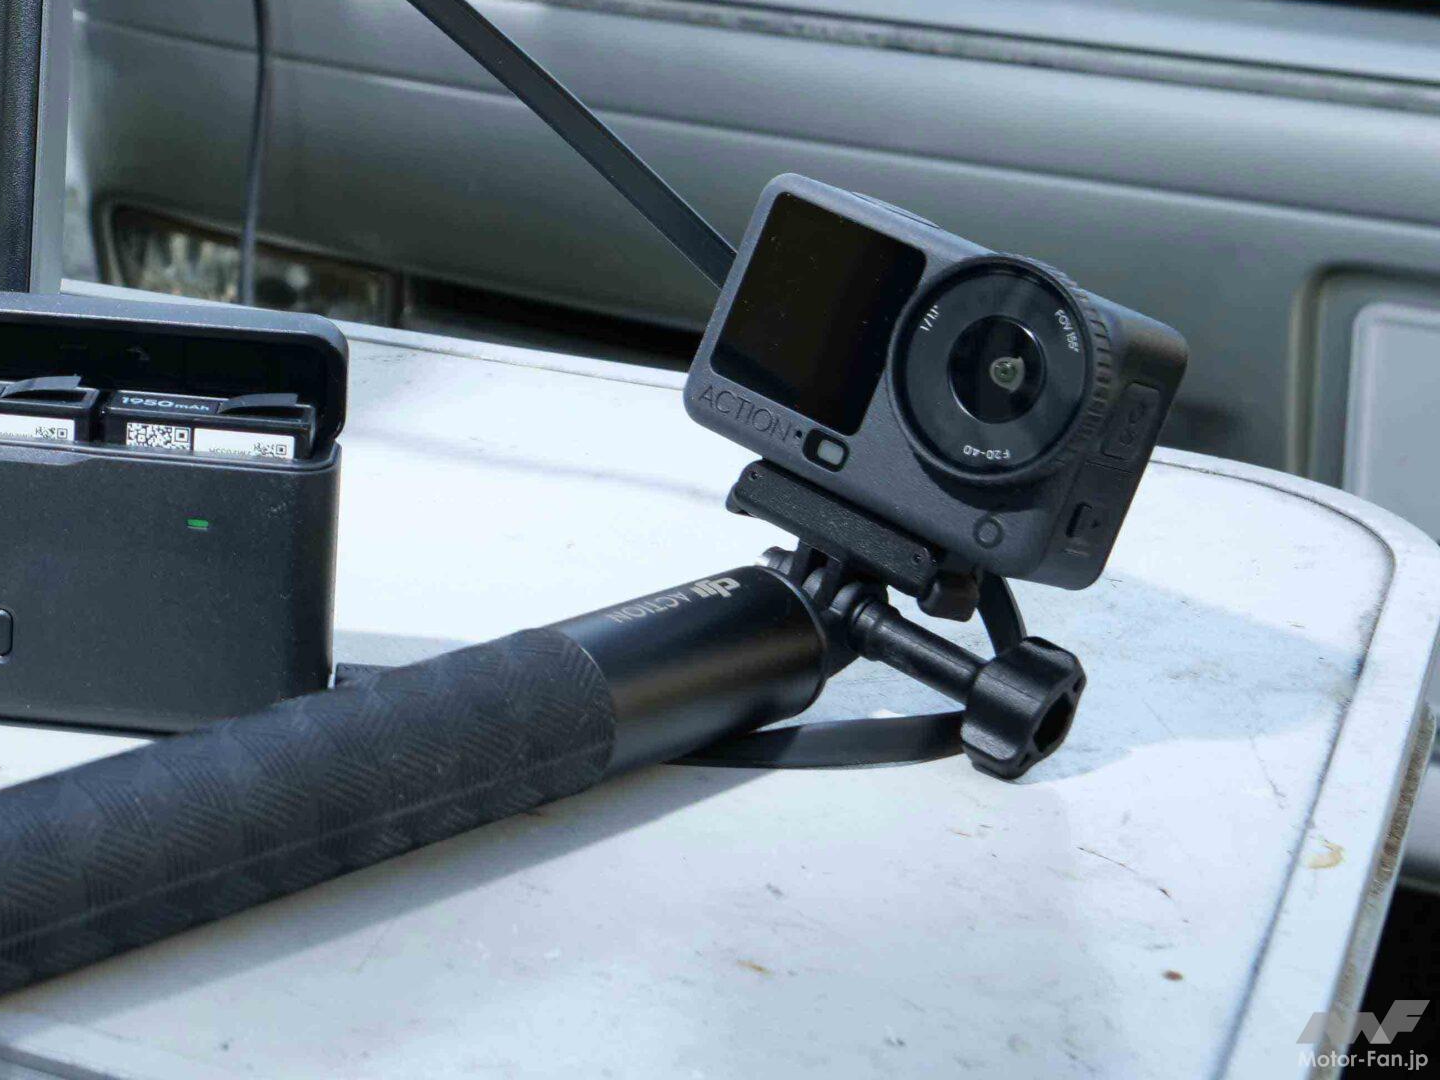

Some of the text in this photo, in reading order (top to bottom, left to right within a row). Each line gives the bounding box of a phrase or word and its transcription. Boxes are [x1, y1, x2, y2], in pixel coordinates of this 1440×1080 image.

[1054, 309, 1073, 331] FOV
[699, 385, 793, 443] ACTION
[607, 591, 692, 624] ACTION
